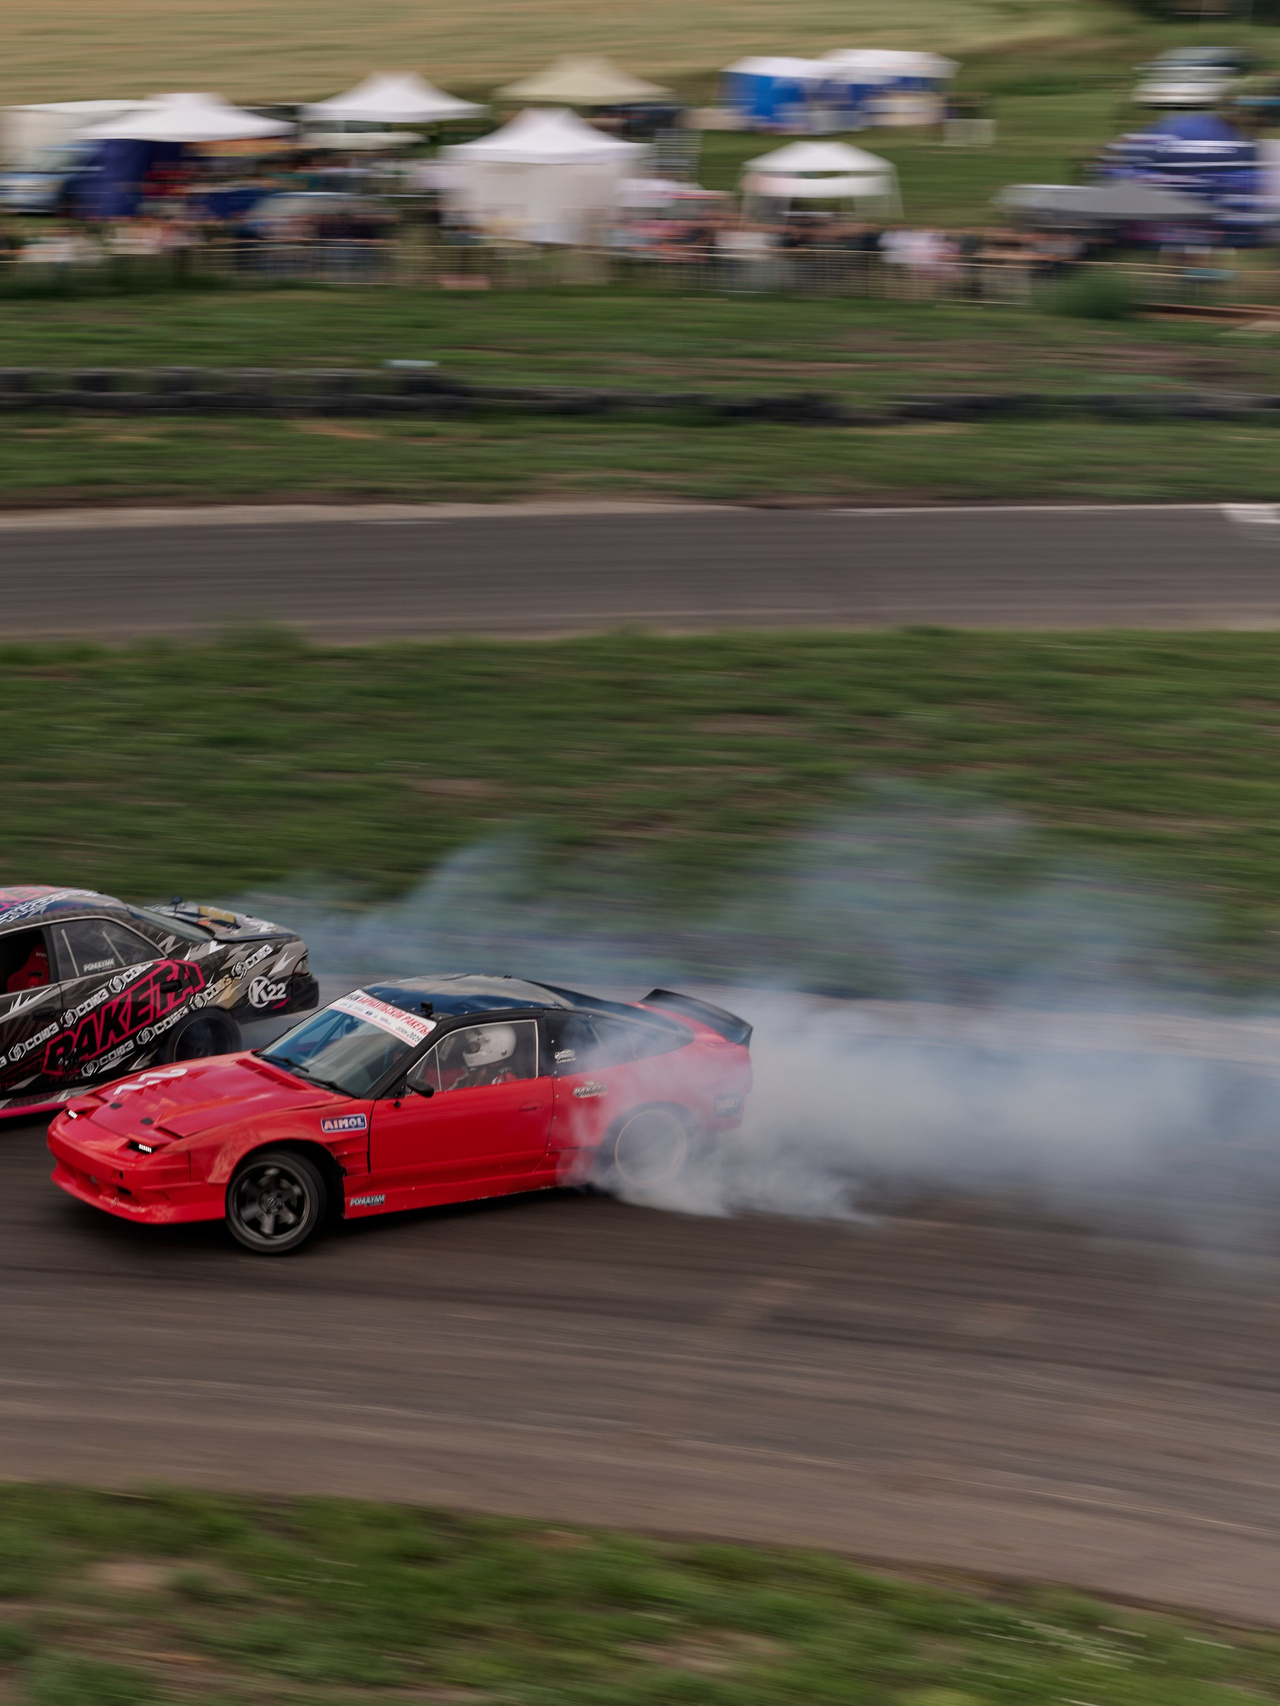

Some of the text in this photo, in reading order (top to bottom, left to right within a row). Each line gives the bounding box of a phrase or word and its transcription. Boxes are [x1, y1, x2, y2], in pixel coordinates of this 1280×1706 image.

[25, 1021, 60, 1050] СОЮЗ
[76, 987, 110, 1016] СОЮЗ
[98, 1039, 134, 1065] СОЮЗ
[324, 1117, 365, 1130] AIMOL
